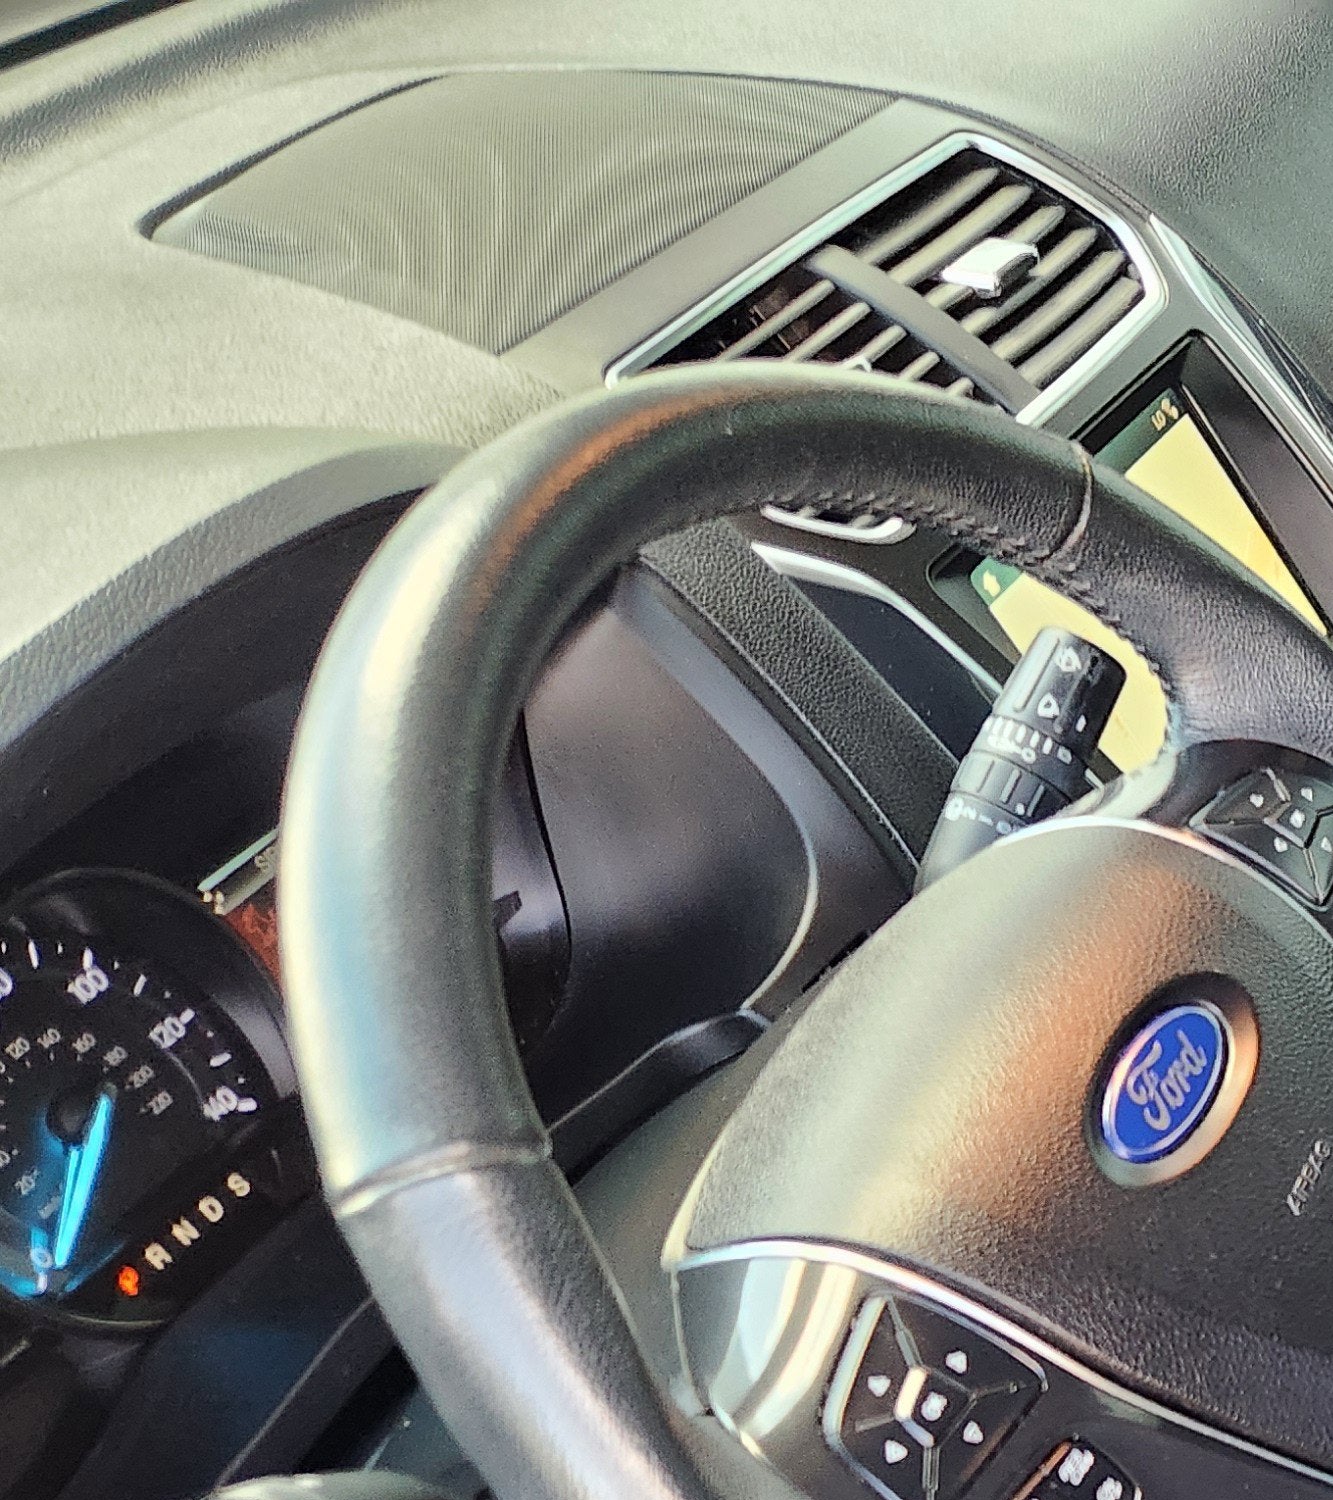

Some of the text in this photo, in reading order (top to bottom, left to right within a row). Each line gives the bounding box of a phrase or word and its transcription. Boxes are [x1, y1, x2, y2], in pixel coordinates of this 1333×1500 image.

[67, 965, 109, 1004] 100
[149, 1016, 186, 1049] 120
[1126, 1029, 1208, 1131] Ford
[144, 1242, 173, 1270] R
[171, 1216, 201, 1247] N
